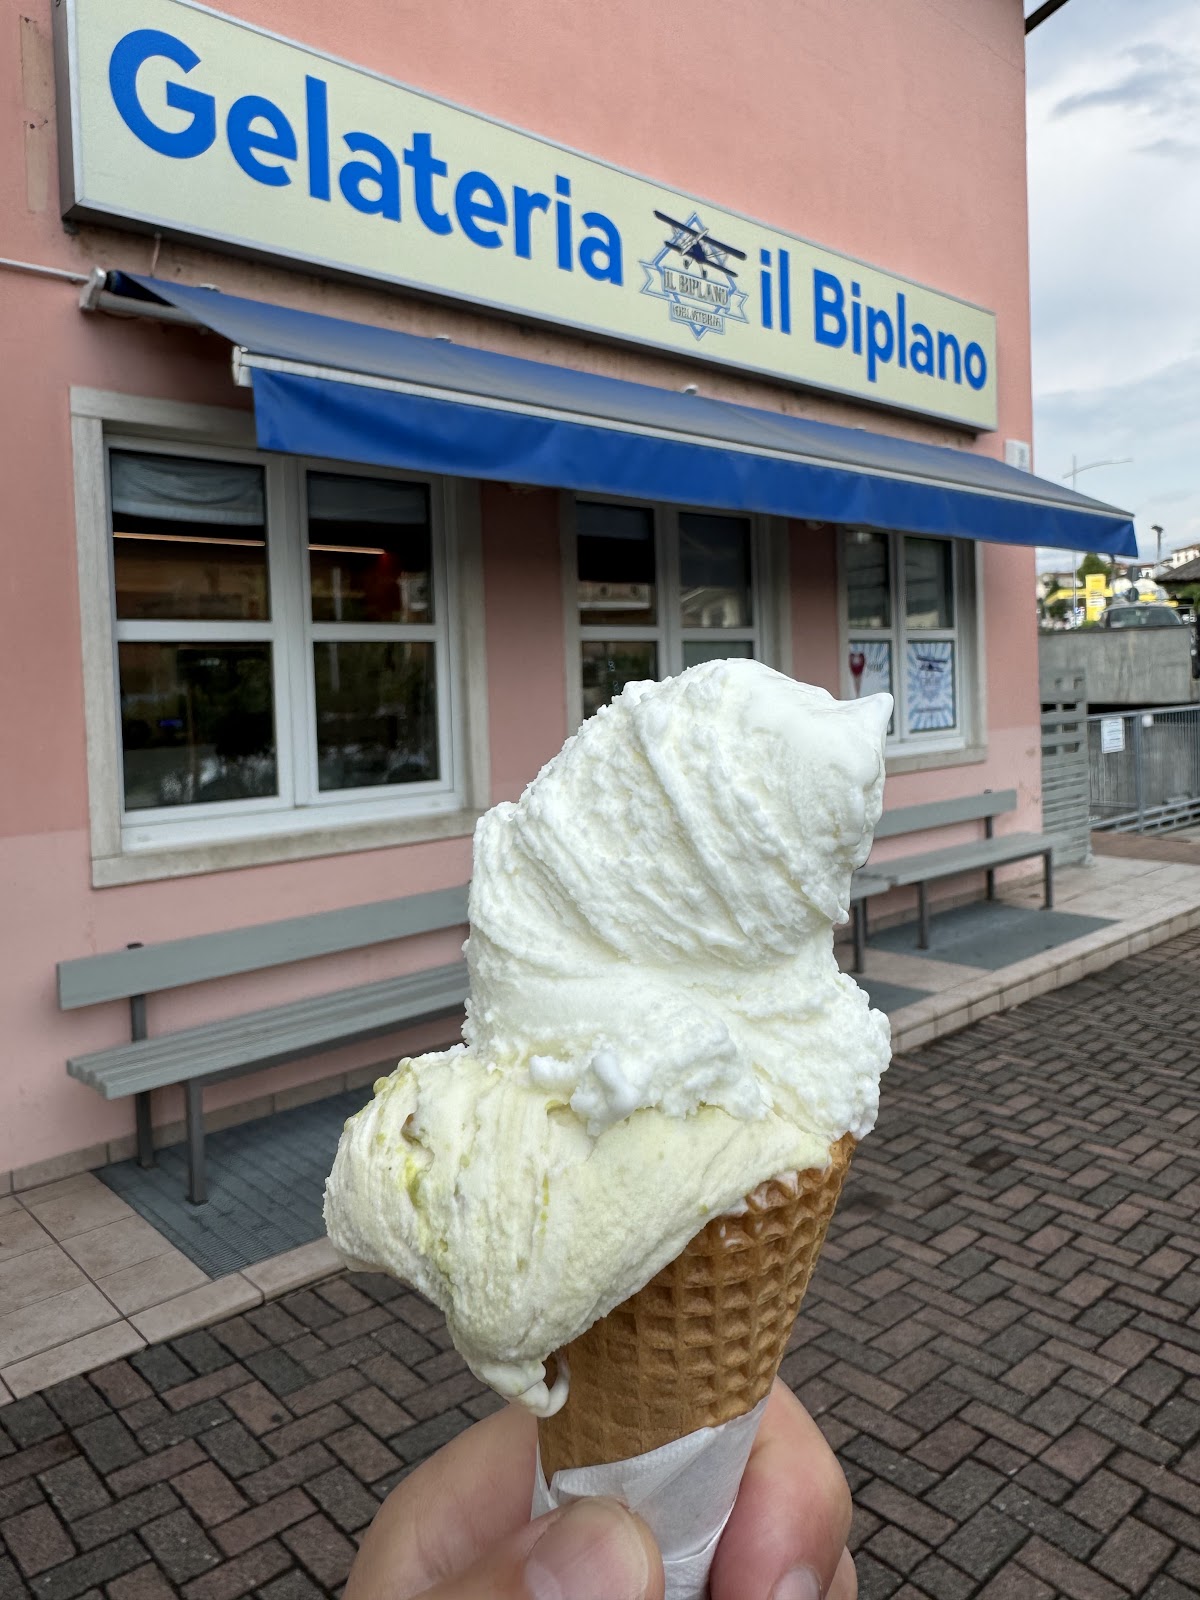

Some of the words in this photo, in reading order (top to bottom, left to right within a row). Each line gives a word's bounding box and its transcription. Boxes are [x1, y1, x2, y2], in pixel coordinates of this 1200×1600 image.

[109, 29, 623, 286] Gelateria
[760, 248, 791, 335] il
[813, 268, 987, 391] Biplano
